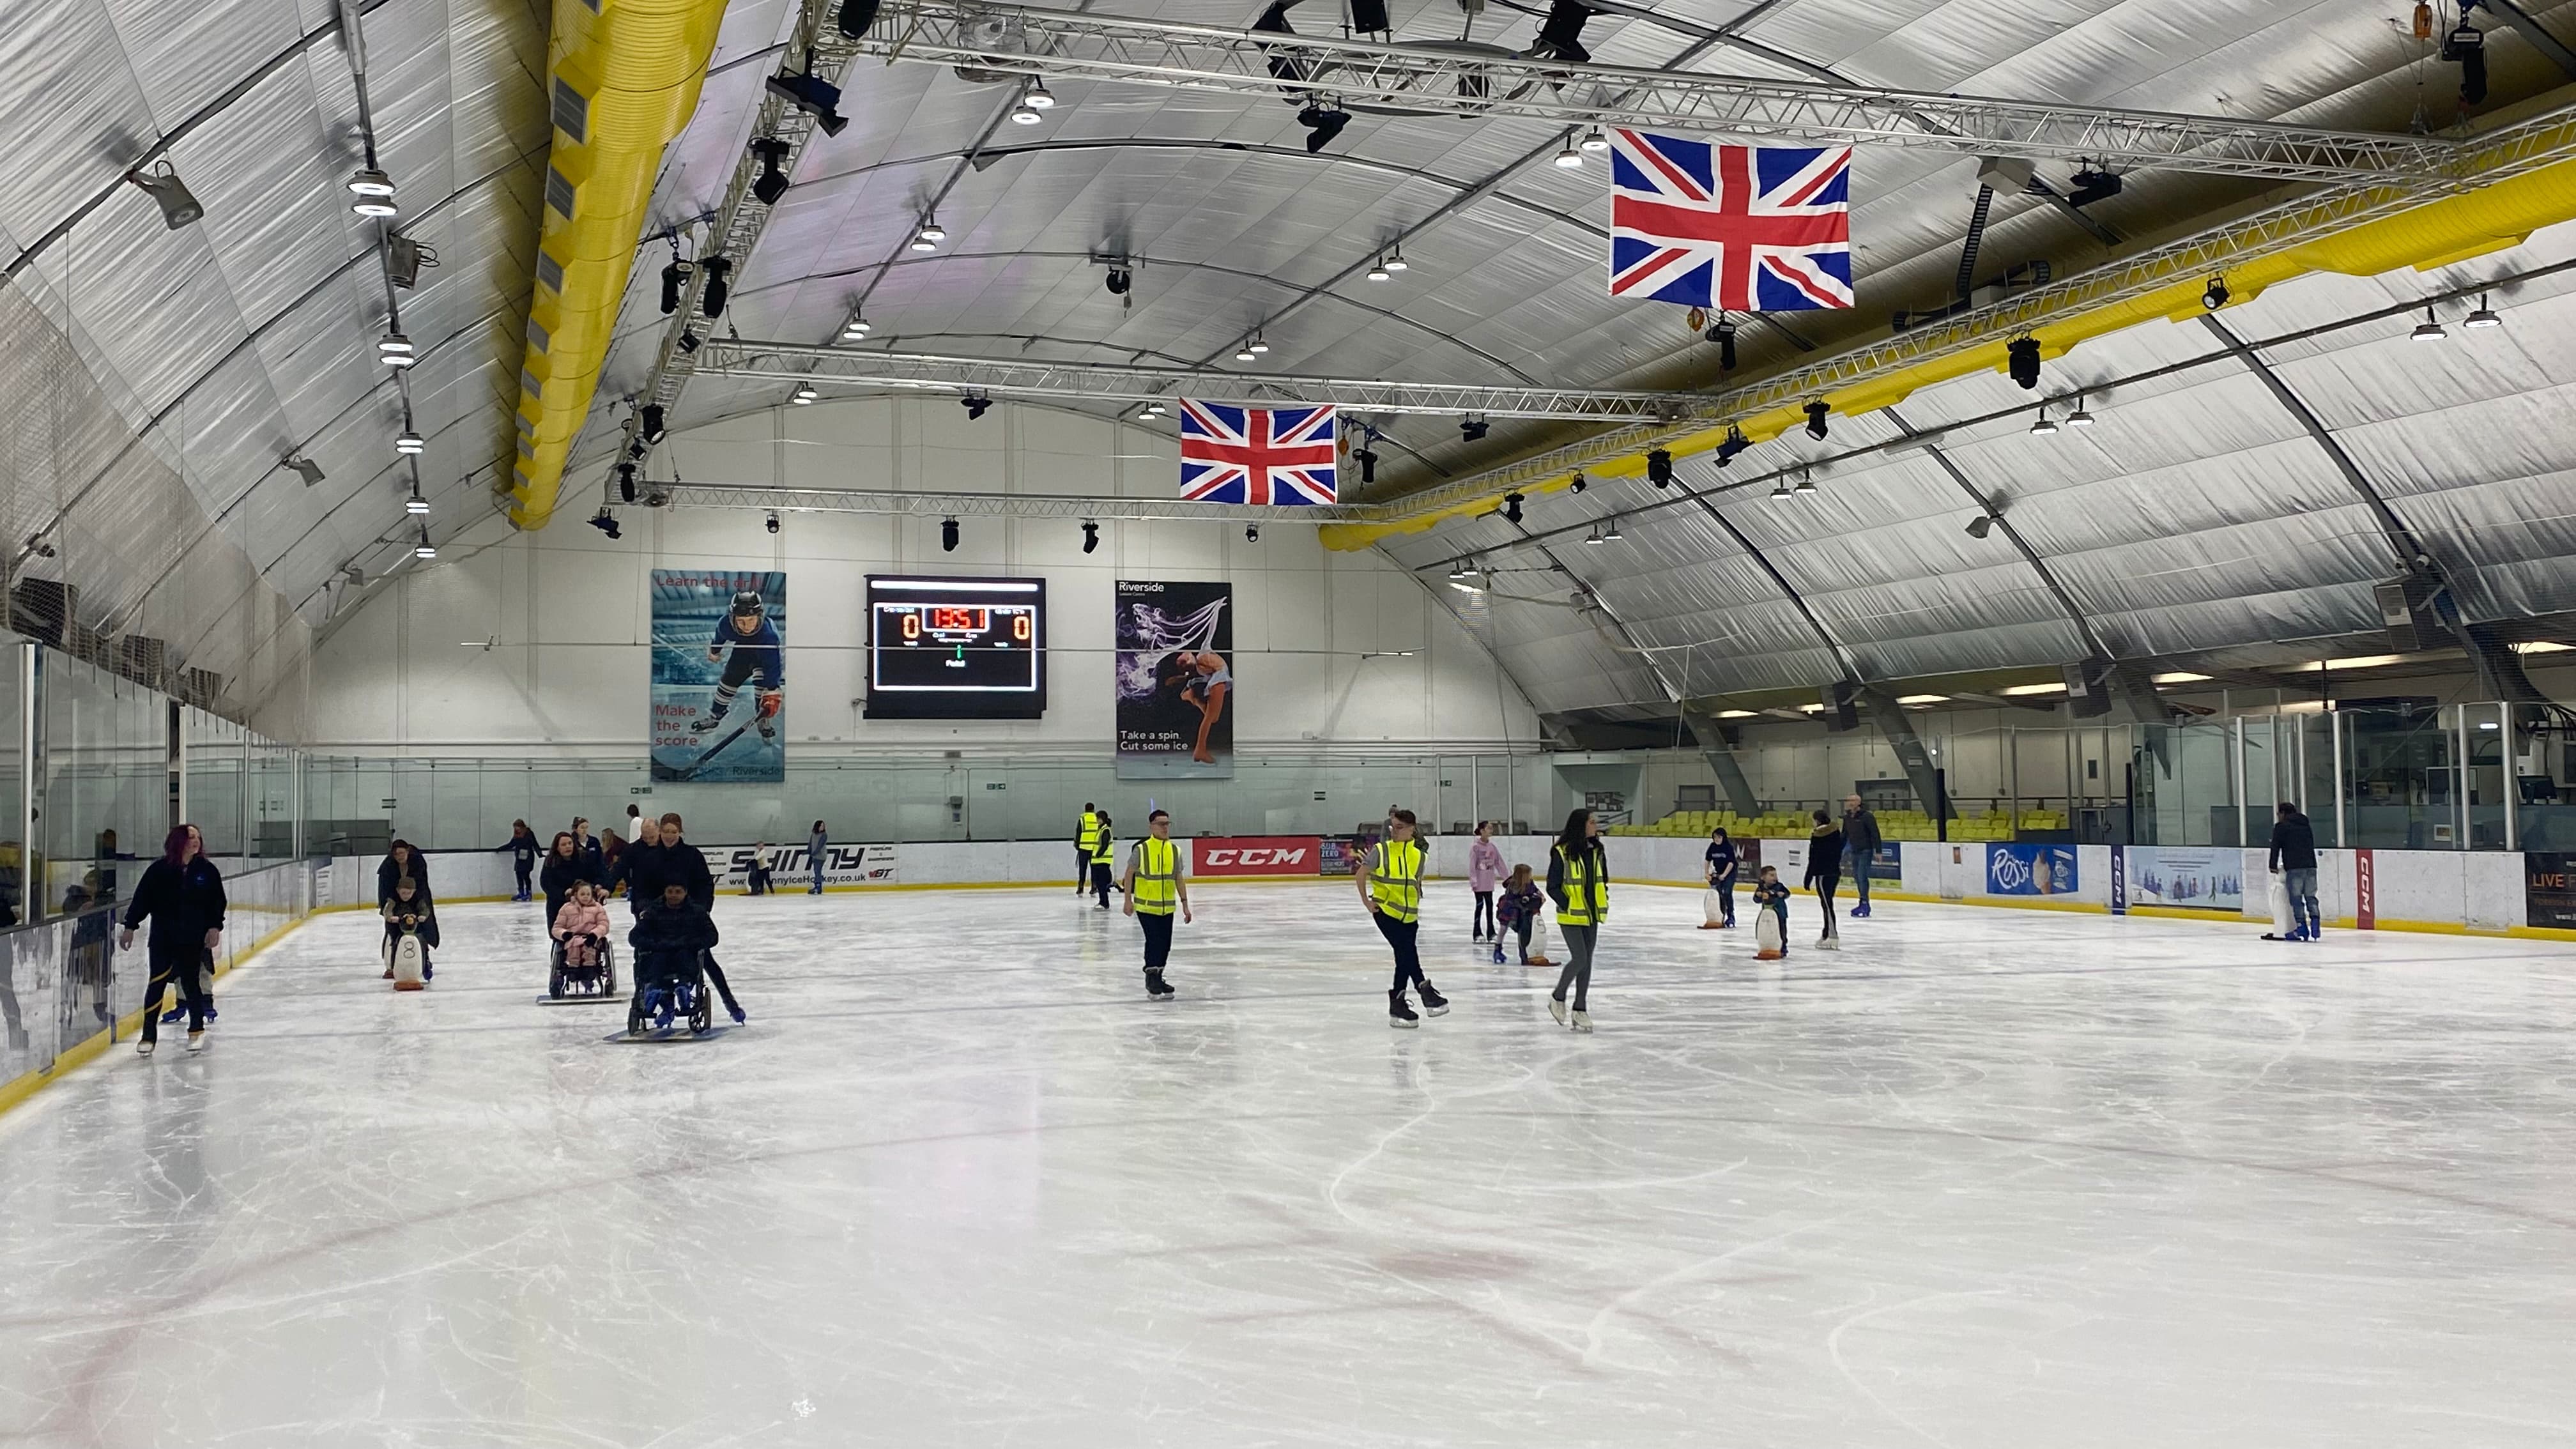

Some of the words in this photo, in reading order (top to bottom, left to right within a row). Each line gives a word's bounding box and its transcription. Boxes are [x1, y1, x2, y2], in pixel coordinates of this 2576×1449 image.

[657, 575, 698, 586] Learn
[704, 576, 728, 587] the
[1119, 581, 1165, 592] Riverside
[903, 615, 919, 638] 0
[1014, 617, 1029, 640] 0
[656, 705, 696, 716] Make
[656, 720, 680, 731] the
[1120, 731, 1146, 739] Take
[656, 737, 698, 746] score
[1120, 741, 1139, 750] Cut
[733, 766, 780, 776] Riverside
[1206, 848, 1307, 866] CCM
[2361, 857, 2370, 913] CCM
[2532, 873, 2565, 887] LIVE
[403, 941, 415, 959] 8
